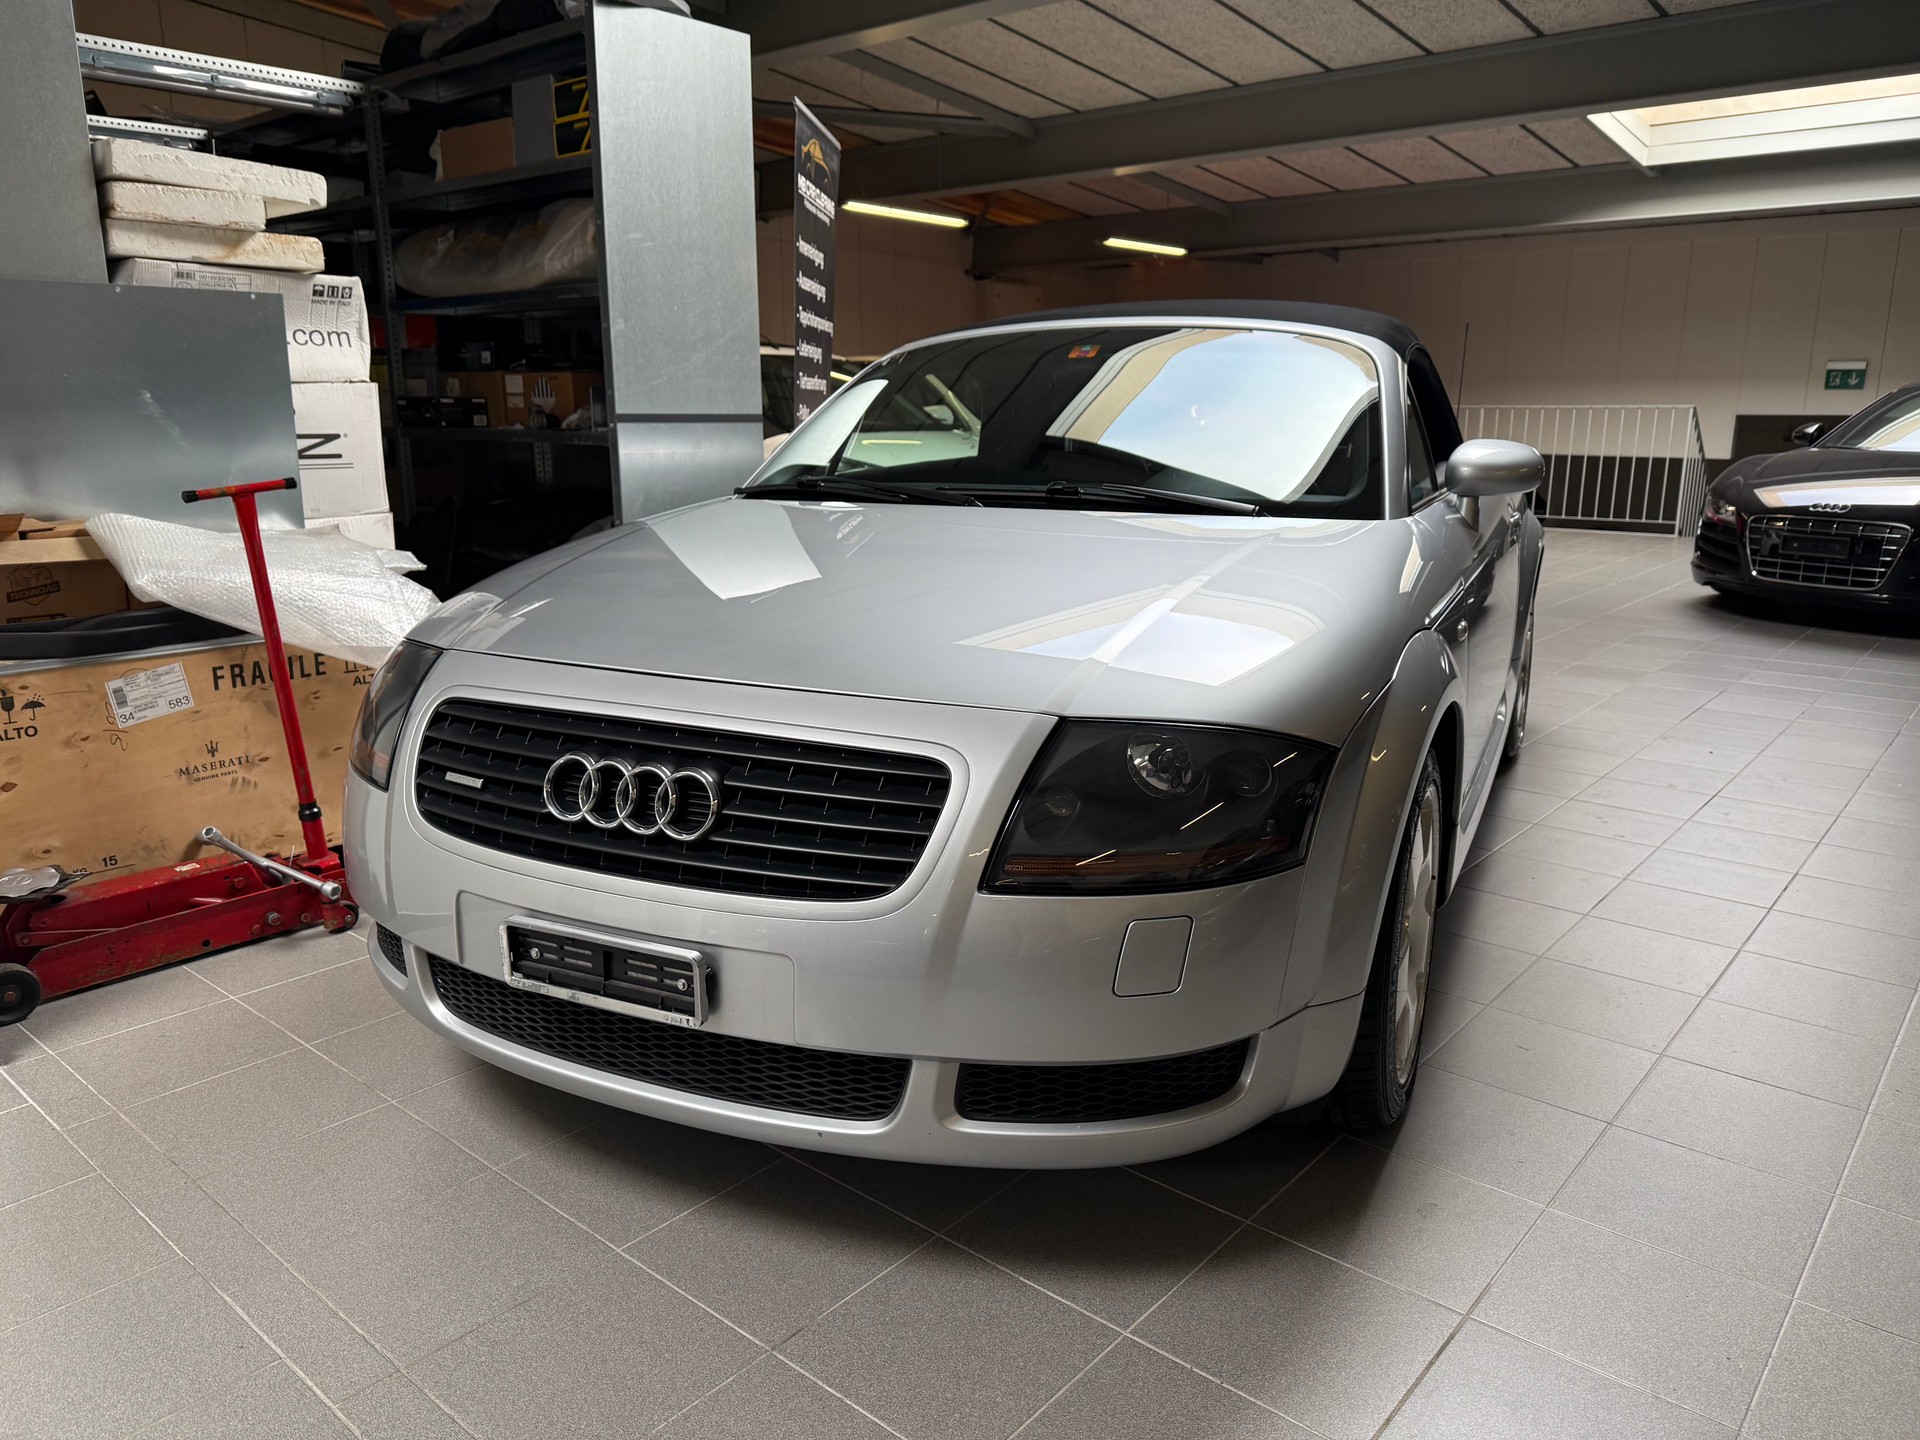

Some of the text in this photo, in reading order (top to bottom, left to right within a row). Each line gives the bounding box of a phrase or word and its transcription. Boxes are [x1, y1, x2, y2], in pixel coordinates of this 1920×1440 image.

[212, 652, 327, 691] FRAILE
[168, 696, 190, 709] 583
[119, 712, 135, 724] 34
[179, 755, 250, 777] MASERATI
[193, 769, 239, 783] GENUINE PARTS
[101, 855, 118, 868] 15
